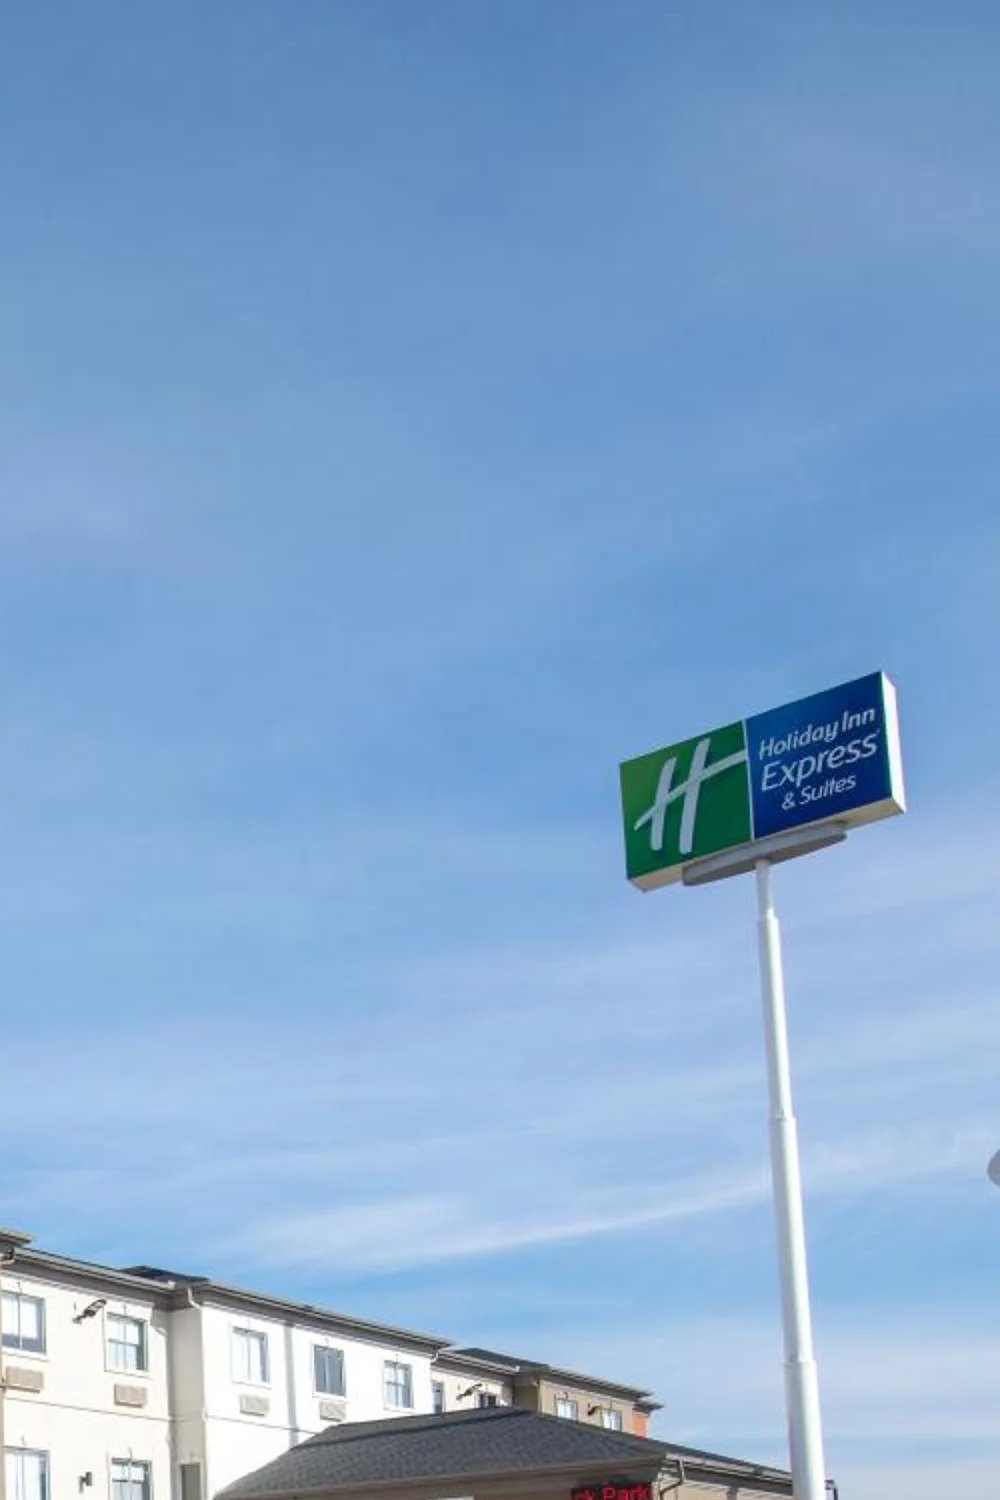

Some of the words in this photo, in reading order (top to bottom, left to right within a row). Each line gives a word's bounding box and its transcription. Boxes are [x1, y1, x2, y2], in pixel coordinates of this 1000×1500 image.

[759, 721, 838, 760] Holiday
[842, 708, 876, 732] Inn
[762, 734, 878, 792] Express
[782, 793, 795, 811] &
[800, 774, 856, 805] Suites
